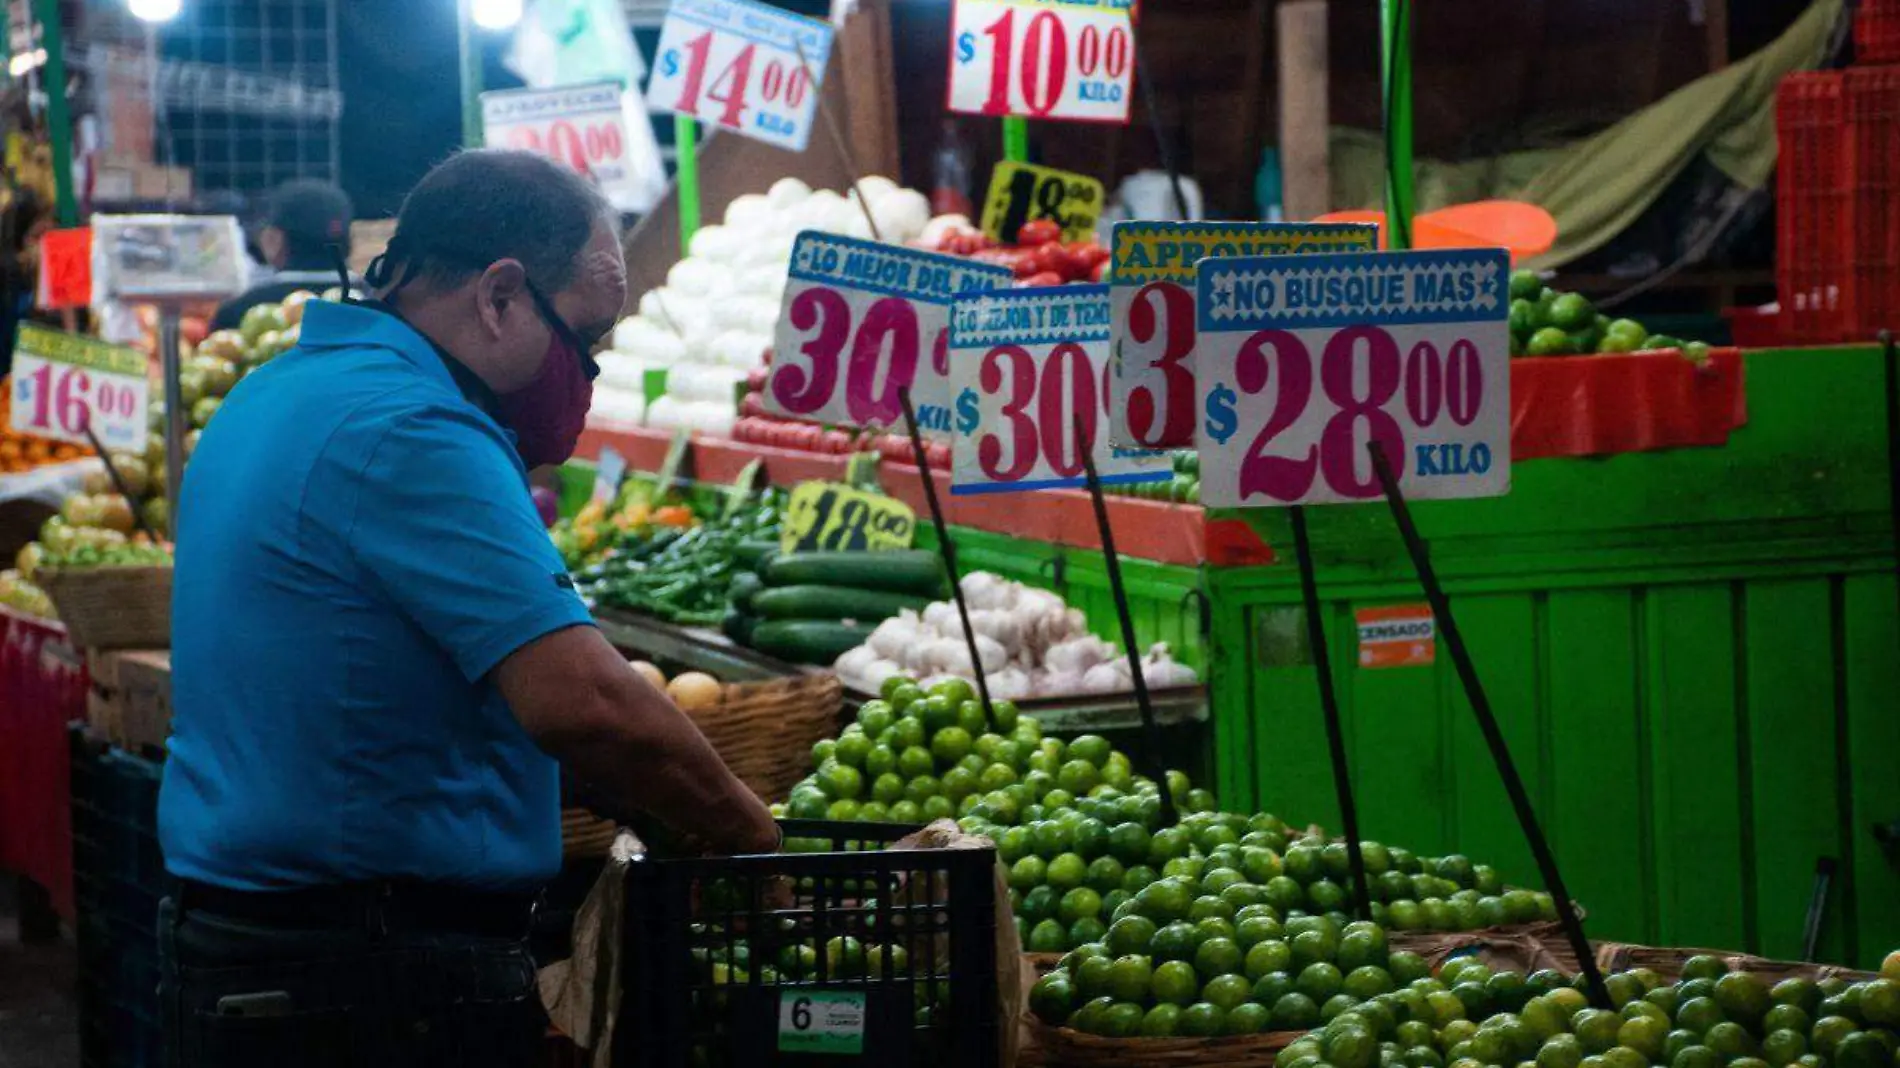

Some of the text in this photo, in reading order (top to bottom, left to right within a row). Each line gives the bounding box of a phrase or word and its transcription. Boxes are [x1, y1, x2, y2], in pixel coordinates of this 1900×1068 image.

[1078, 80, 1123, 101] KILO
[811, 247, 839, 273] LO
[844, 252, 912, 287] MEJOR
[916, 265, 951, 294] DEL
[1235, 271, 1476, 310] NO BUSQUE MAS
[983, 306, 1031, 331] EJOR
[917, 403, 952, 433] KIL
[1415, 442, 1492, 477] KILO
[791, 996, 812, 1031] 6
